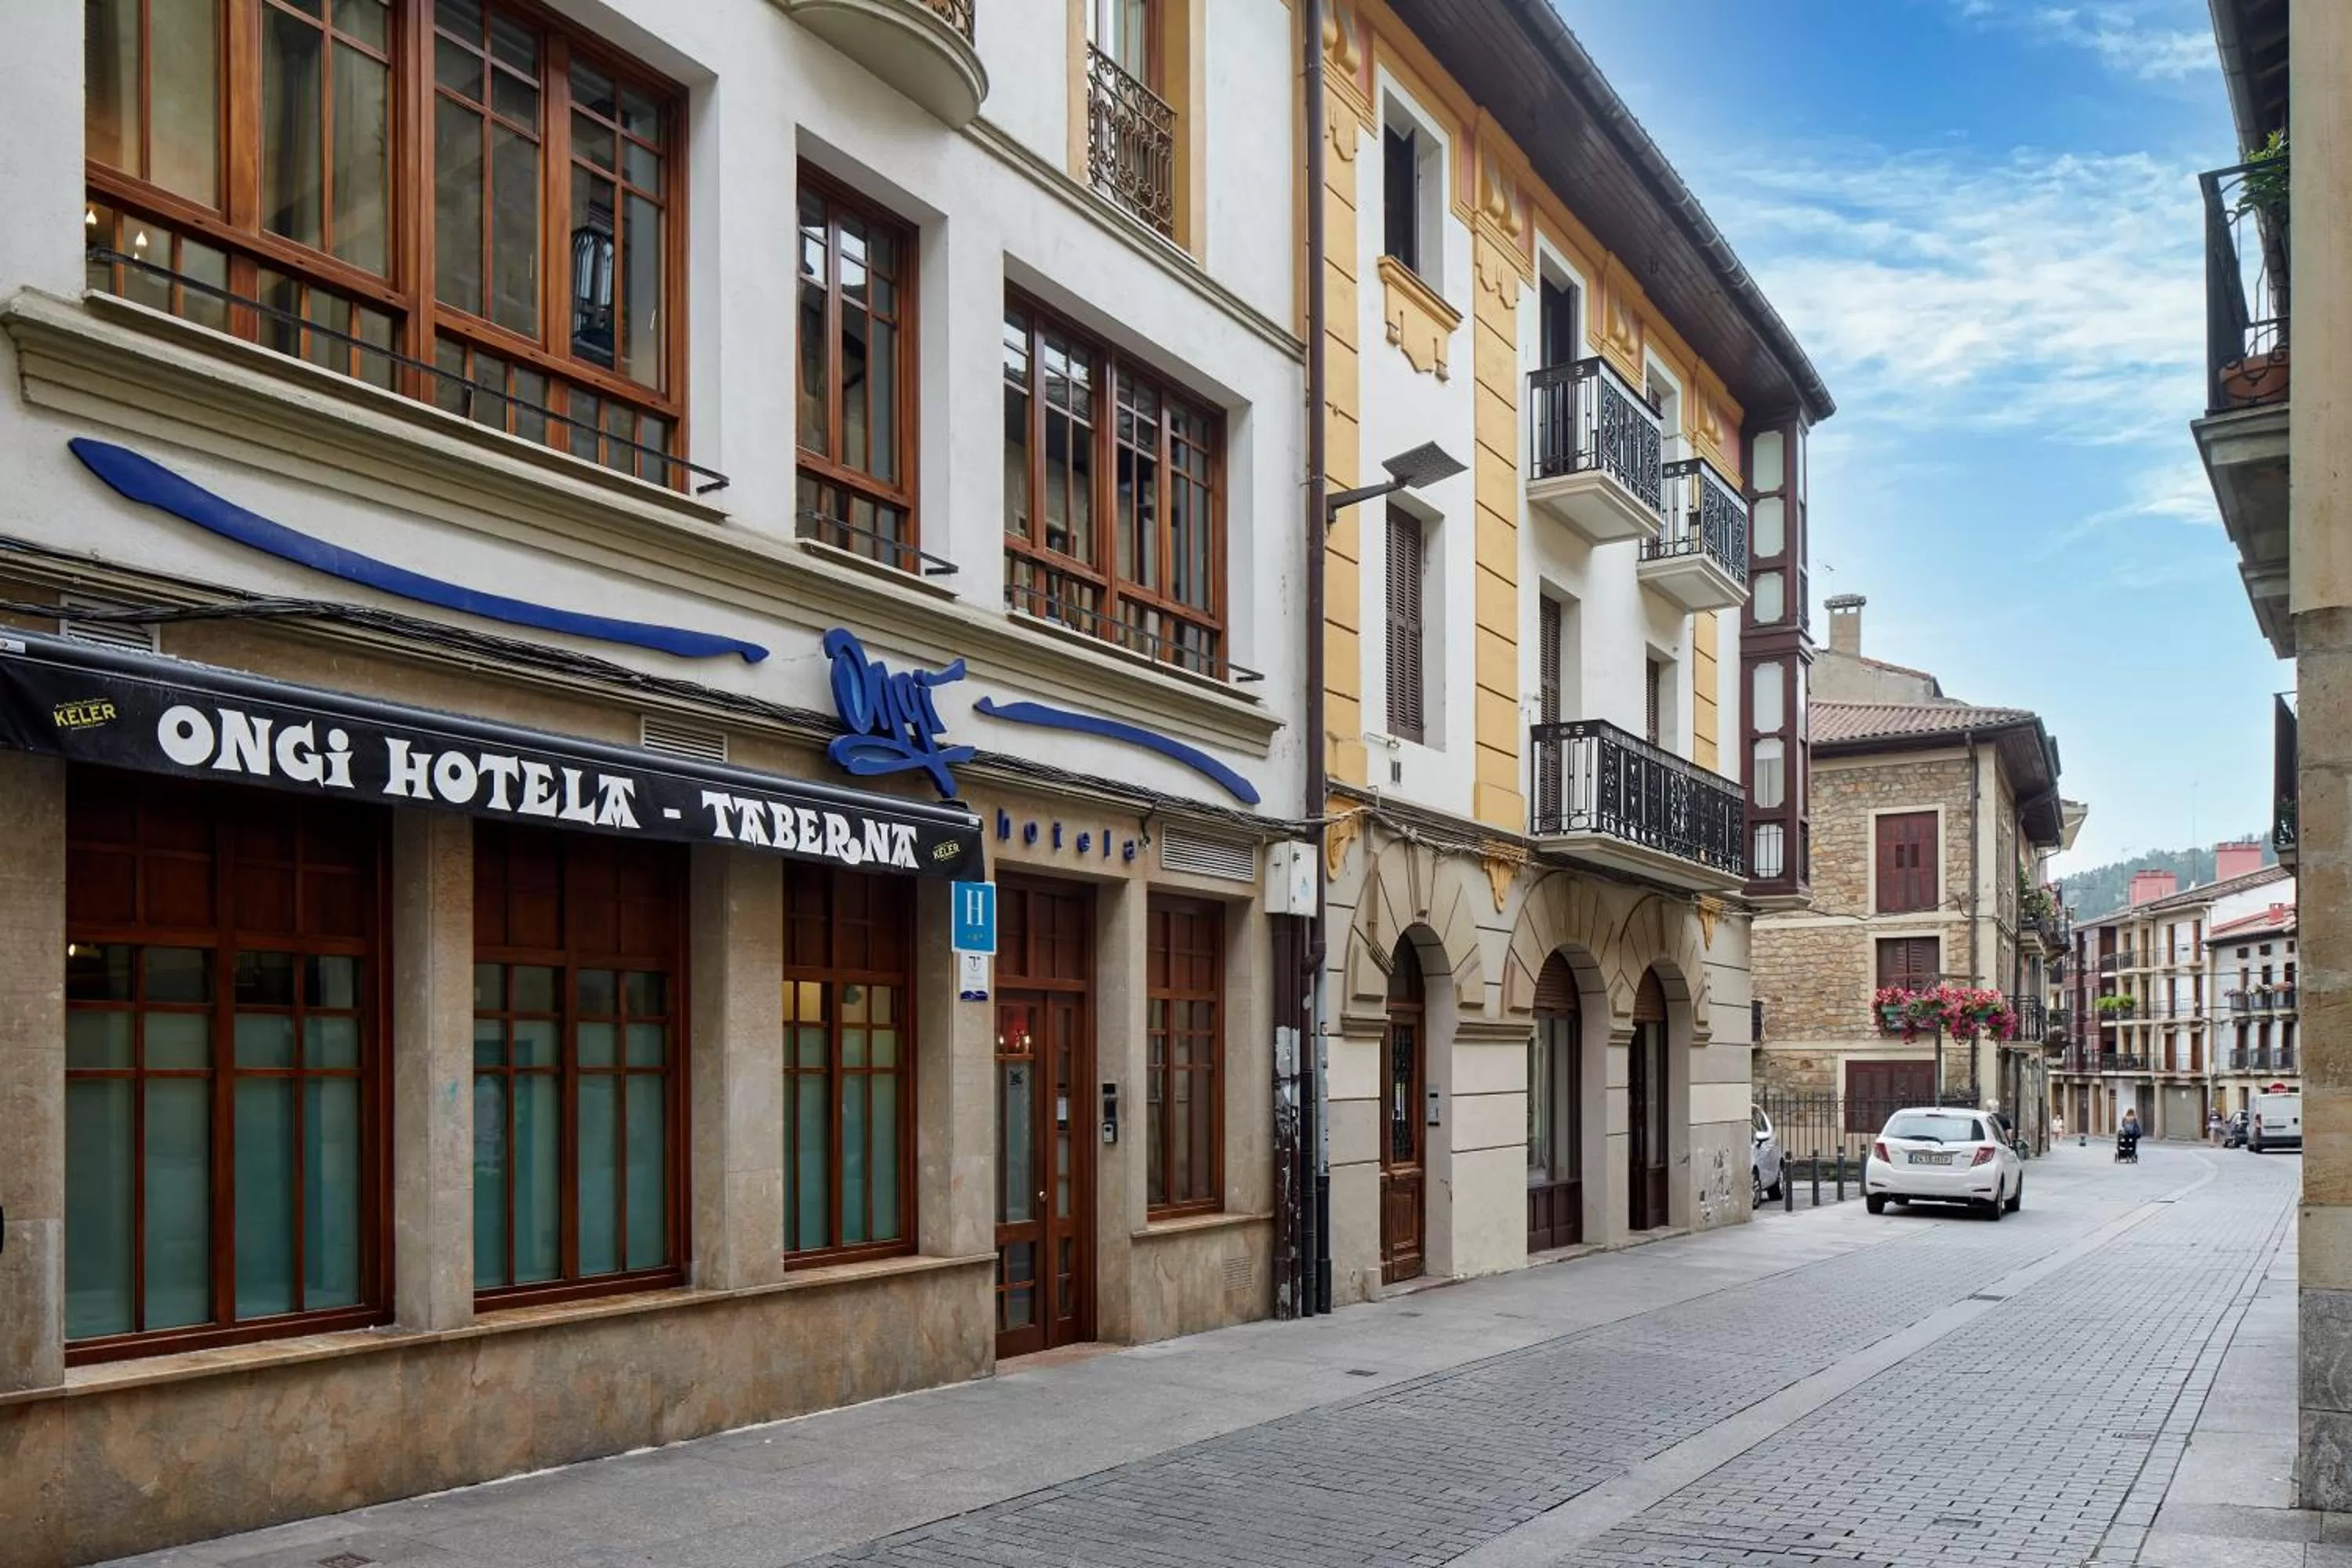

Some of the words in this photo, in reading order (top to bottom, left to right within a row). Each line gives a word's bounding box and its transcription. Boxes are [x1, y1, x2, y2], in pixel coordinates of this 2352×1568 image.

[53, 703, 117, 727] KELER
[383, 737, 641, 829] HOTELA
[701, 789, 920, 869] TABERNA
[933, 843, 960, 860] KELER
[996, 807, 1135, 861] hotela
[965, 889, 985, 926] H
